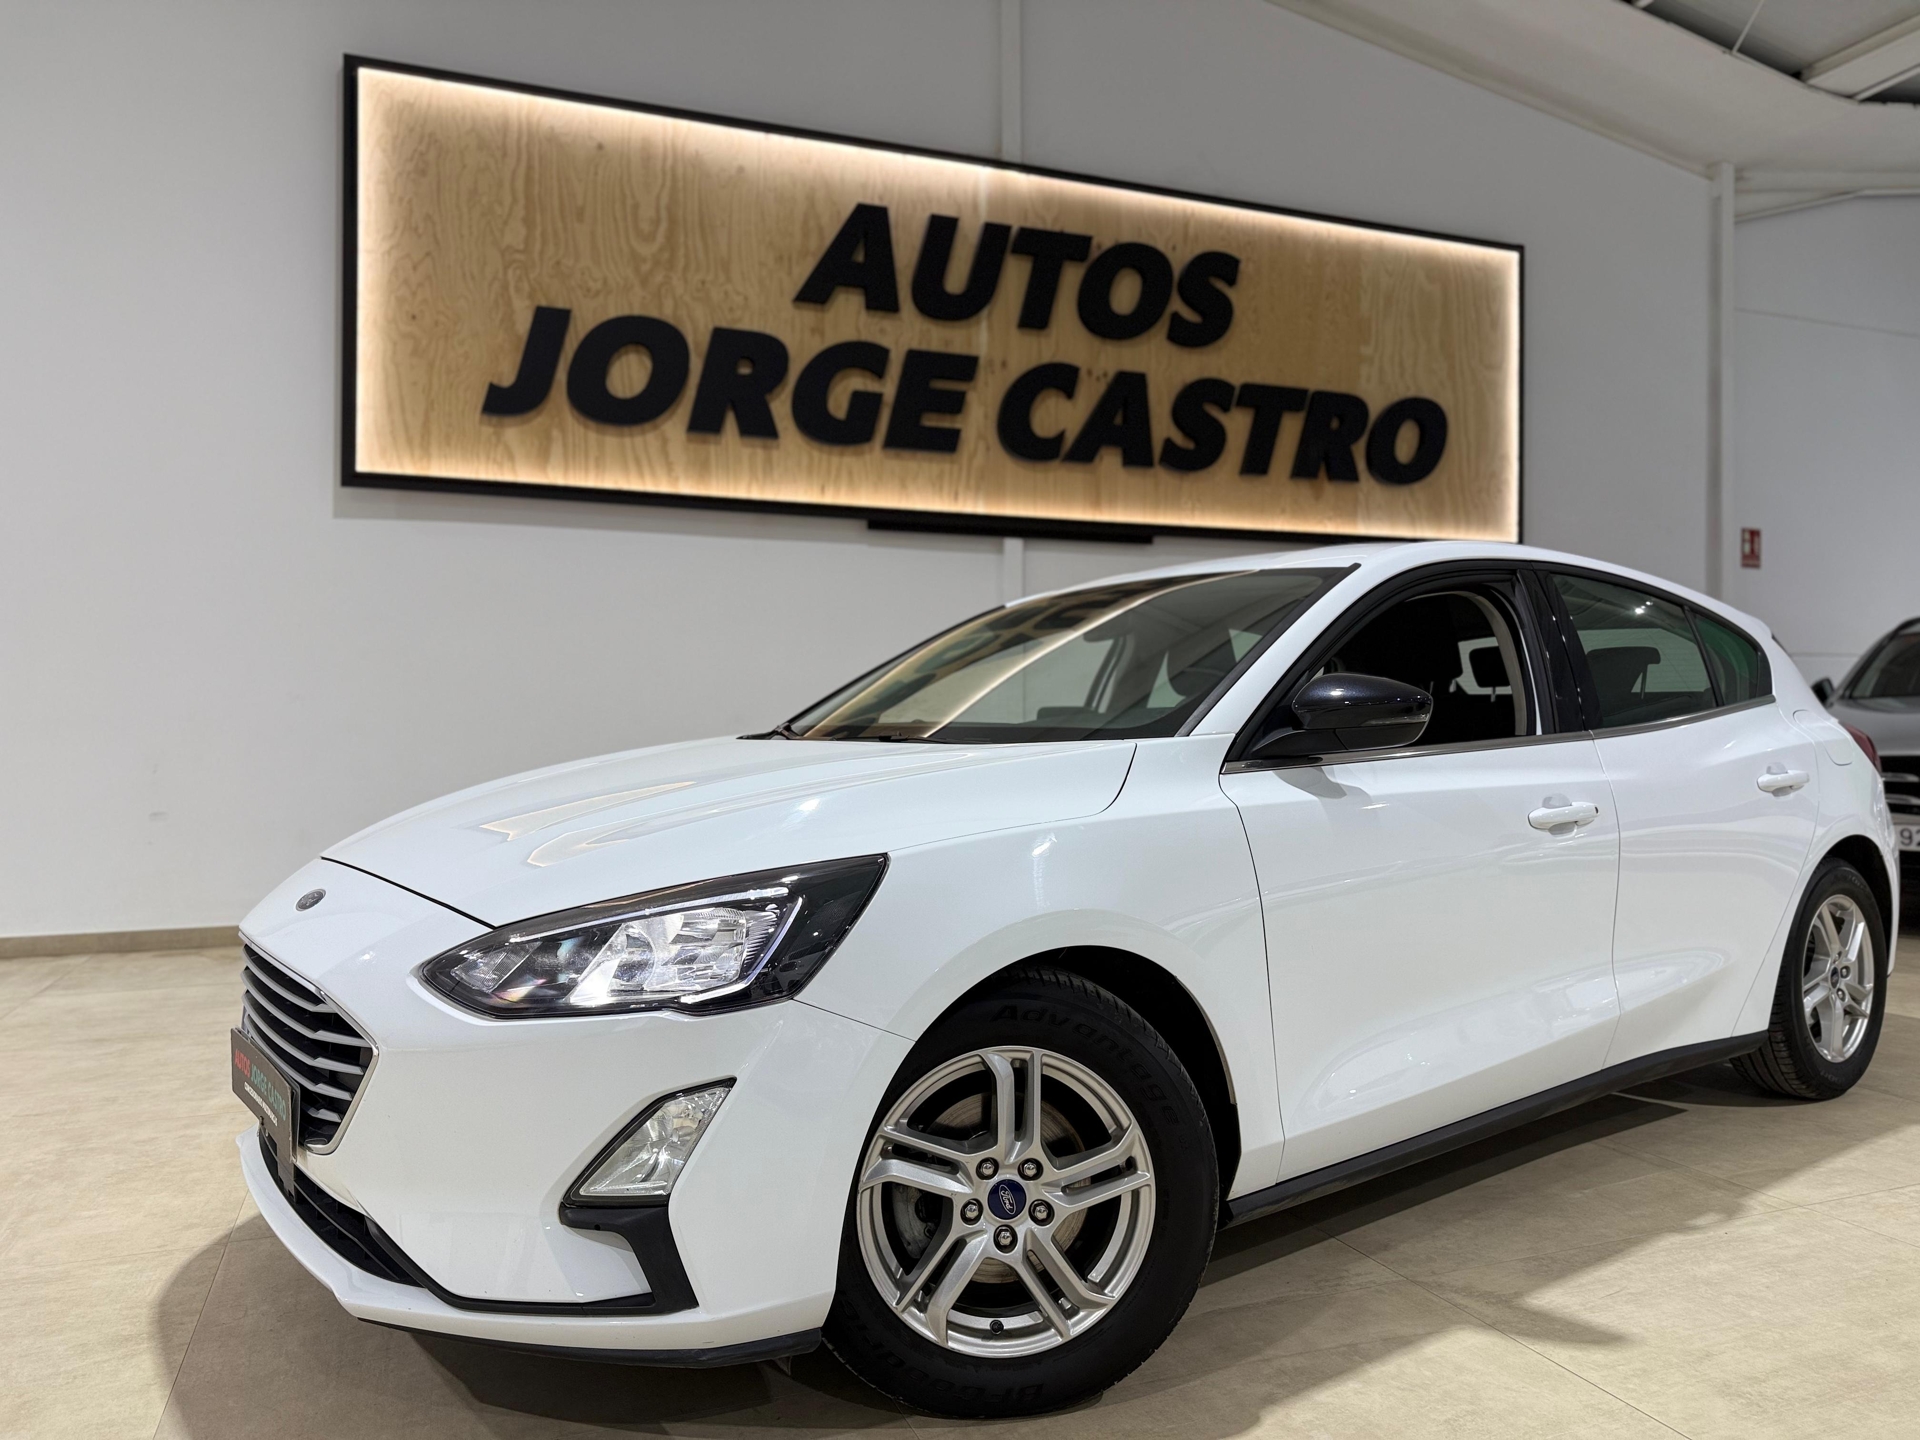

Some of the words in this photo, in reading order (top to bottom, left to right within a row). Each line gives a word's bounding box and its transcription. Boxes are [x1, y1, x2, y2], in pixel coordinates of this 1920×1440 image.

[793, 203, 1241, 350] AUTOS
[481, 305, 980, 454] JORGE
[996, 361, 1449, 487] CASTRO
[234, 1048, 251, 1079] AUTOS
[268, 1081, 286, 1121] CASTRO
[989, 1004, 1181, 1127] Advantage
